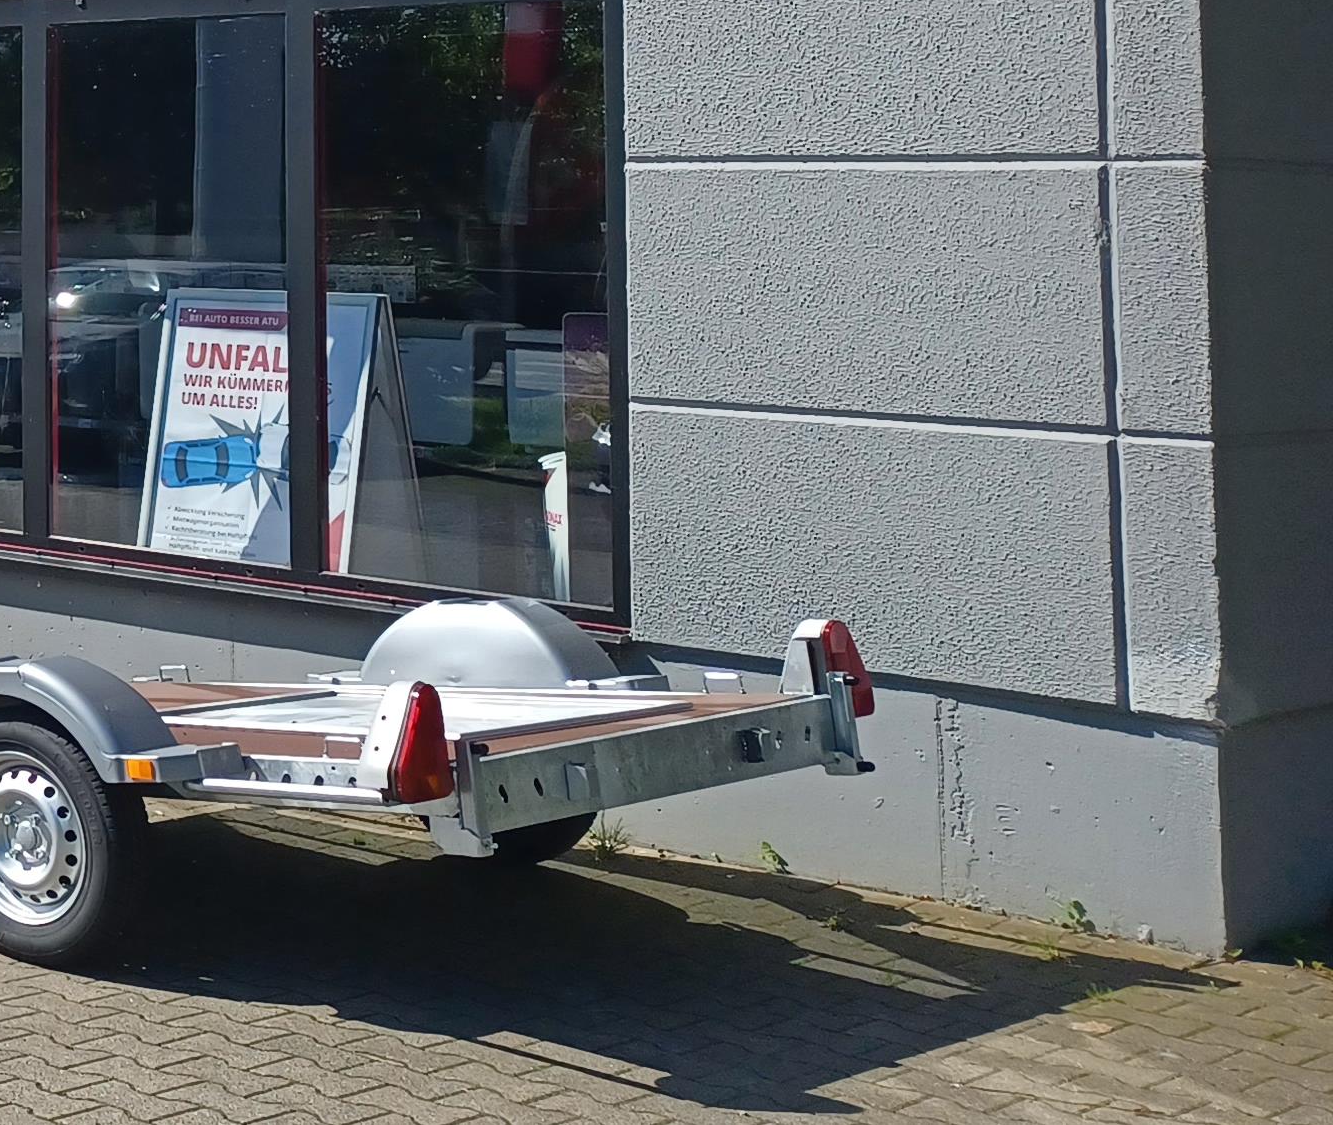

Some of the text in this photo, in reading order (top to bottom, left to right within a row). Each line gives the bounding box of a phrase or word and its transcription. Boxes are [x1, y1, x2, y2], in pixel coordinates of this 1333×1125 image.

[189, 314, 279, 326] BEI AUTO BESSER ATU
[184, 373, 213, 389] WIR
[182, 391, 258, 410] UM ALLES!
